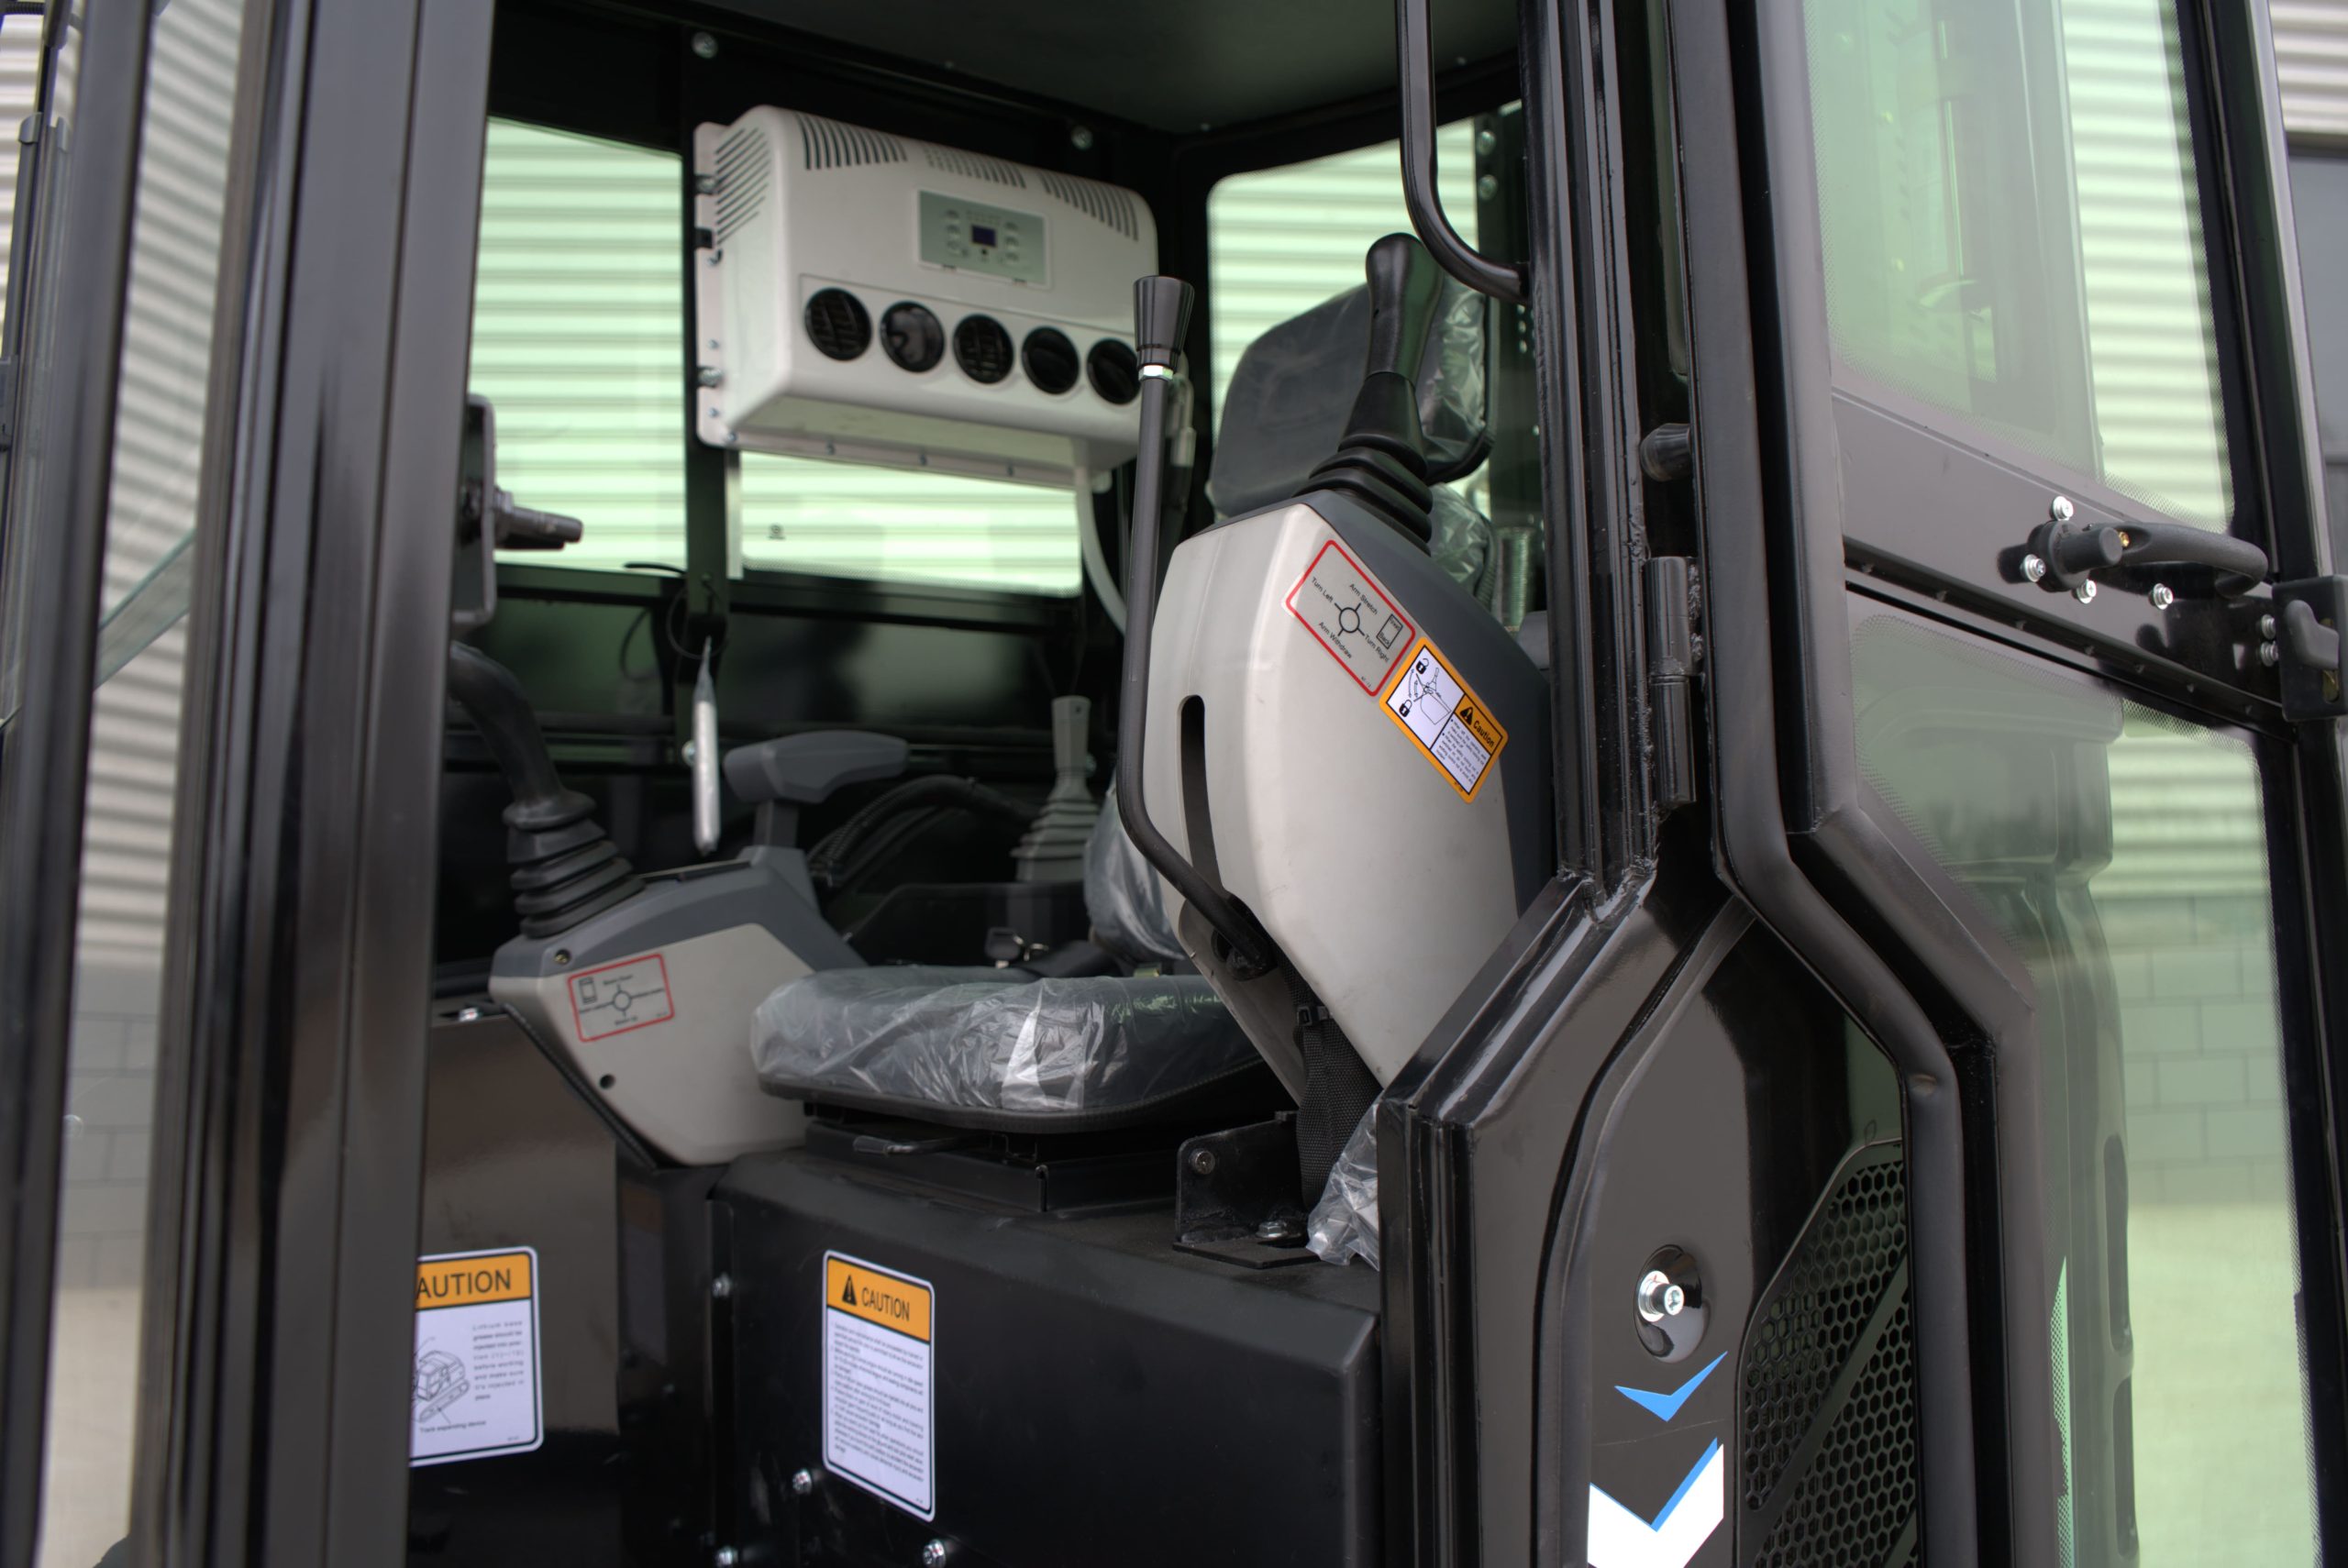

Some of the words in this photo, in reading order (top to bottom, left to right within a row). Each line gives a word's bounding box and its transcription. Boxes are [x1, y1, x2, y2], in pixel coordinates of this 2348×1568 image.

[1312, 577, 1324, 593] Turn
[1323, 591, 1334, 603] Left
[1349, 583, 1361, 596] Arm
[1360, 595, 1378, 615] Stretch
[1319, 622, 1331, 635] Arm
[1330, 635, 1352, 658] Withdraw
[1364, 634, 1377, 649] Turn
[1376, 646, 1390, 663] Right
[1473, 721, 1495, 746] Caution
[415, 1268, 512, 1299] AUTION
[862, 1286, 910, 1321] CAUTION
